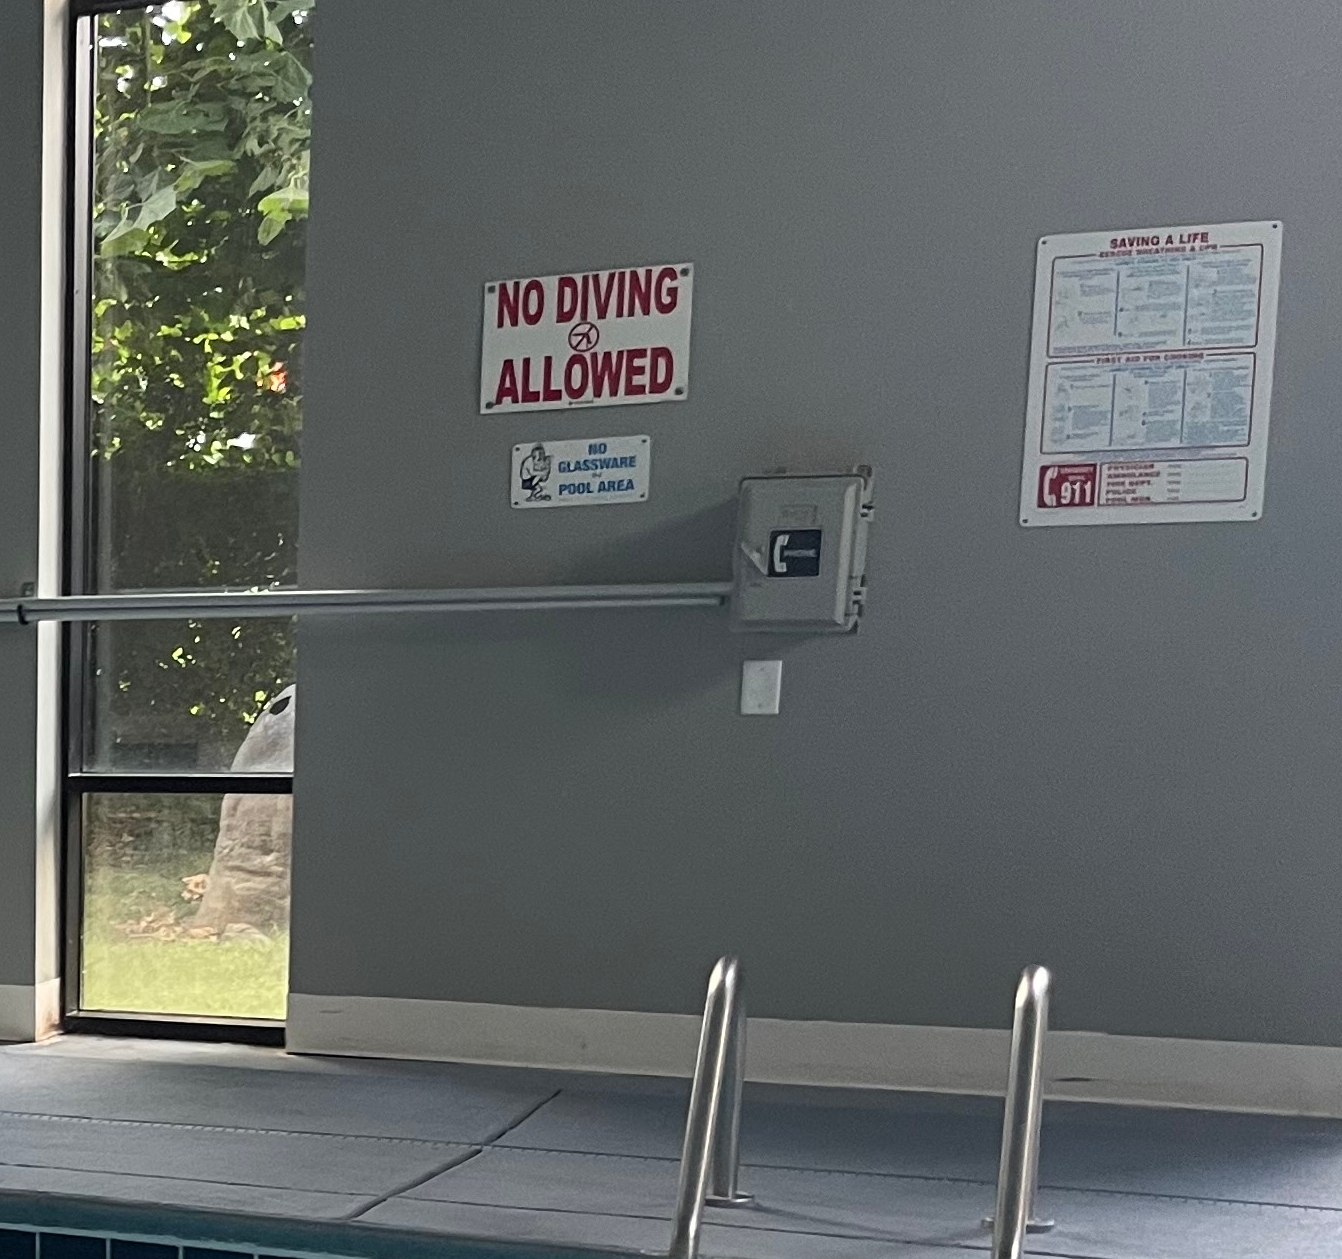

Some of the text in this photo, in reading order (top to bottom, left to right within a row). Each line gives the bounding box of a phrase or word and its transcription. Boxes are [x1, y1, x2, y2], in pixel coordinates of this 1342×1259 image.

[1109, 232, 1209, 249] SAVING A LIFE
[497, 267, 679, 328] NO DIVING
[495, 347, 674, 405] ALLOWED
[588, 443, 607, 455] NO
[558, 455, 636, 473] GLASSWARE
[558, 479, 635, 496] POOL AREA
[1061, 480, 1093, 504] 911
